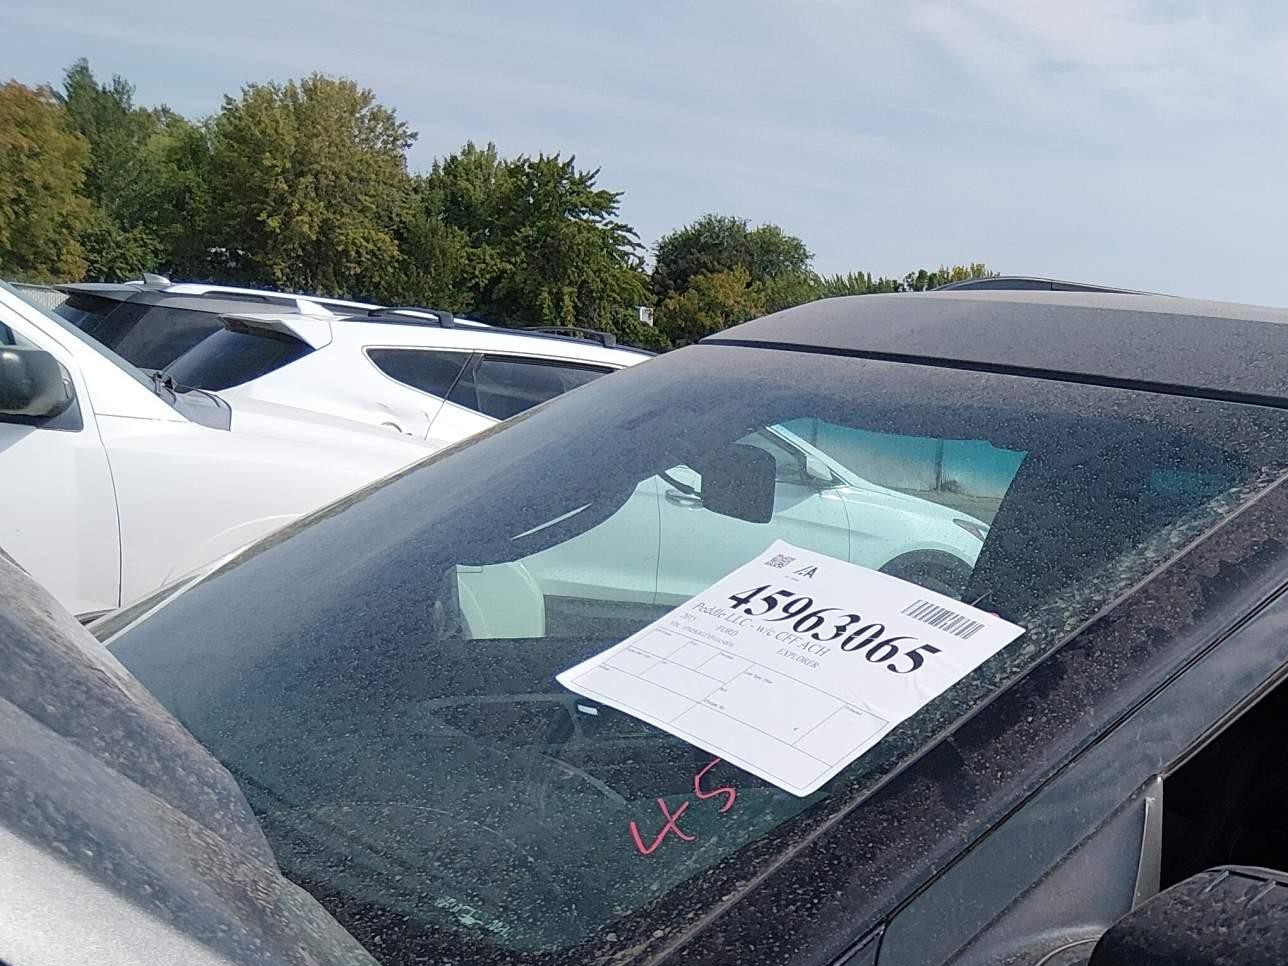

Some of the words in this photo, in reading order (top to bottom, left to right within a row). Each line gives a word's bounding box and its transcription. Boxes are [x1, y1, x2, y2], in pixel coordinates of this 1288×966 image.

[692, 602, 728, 620] Peddle
[725, 614, 753, 629] LLC
[799, 641, 832, 657] ACH
[715, 625, 739, 638] FORD
[777, 648, 821, 669] EXPLORER
[728, 584, 942, 675] 45963065
